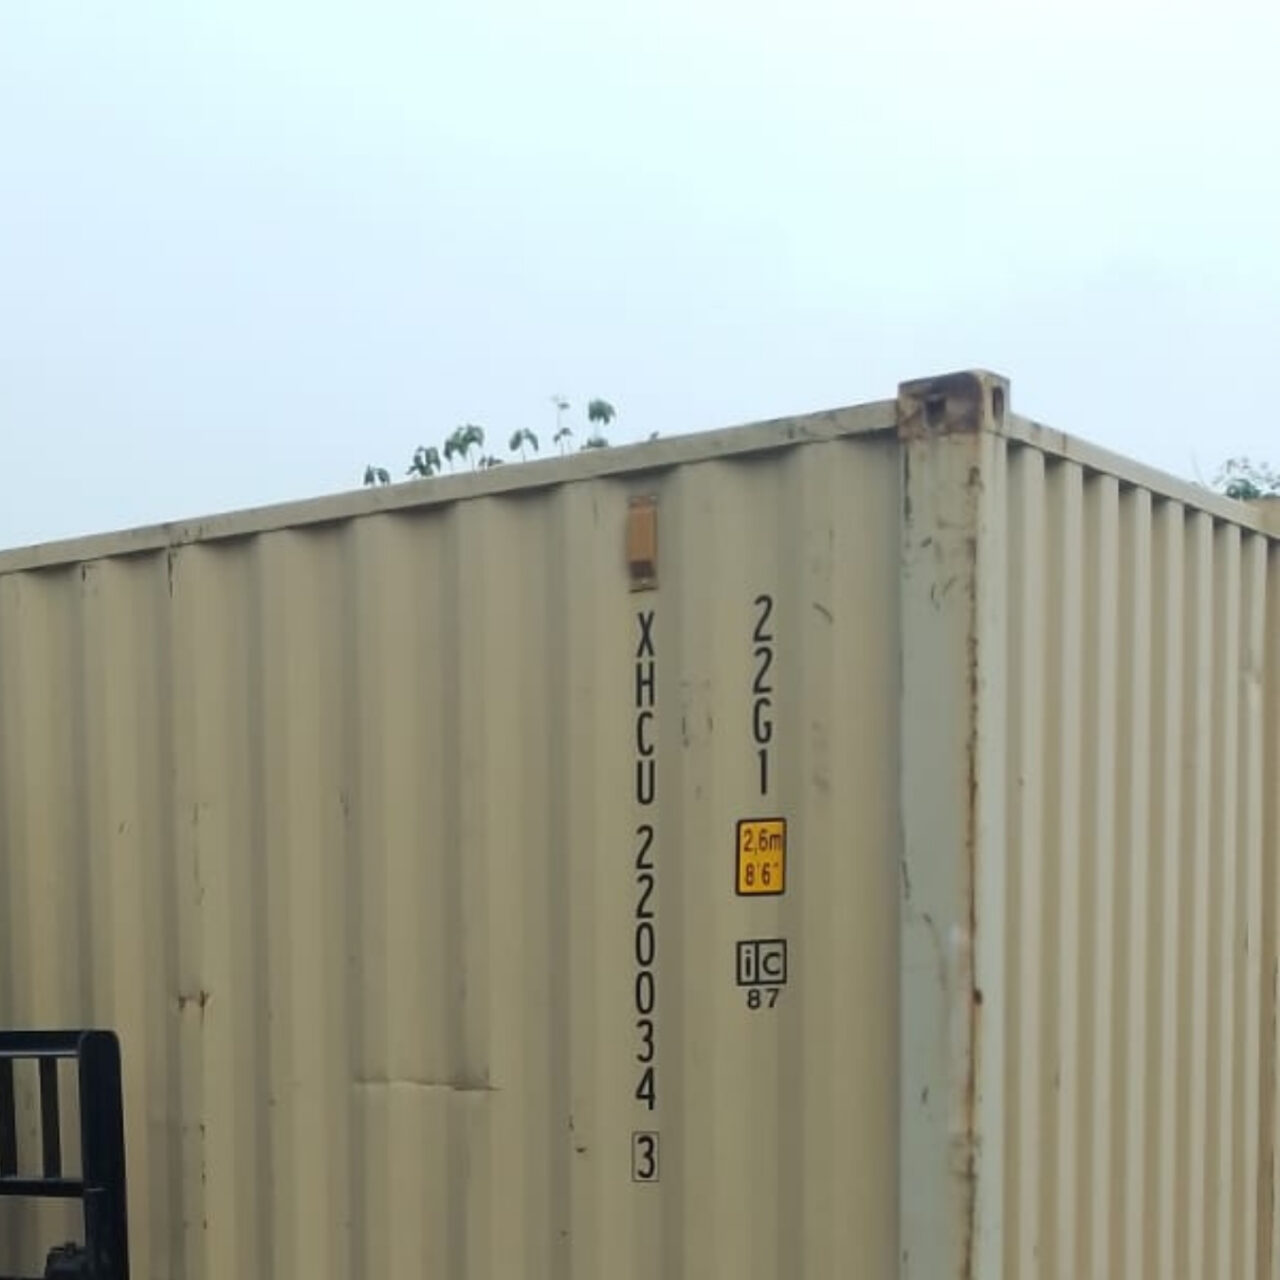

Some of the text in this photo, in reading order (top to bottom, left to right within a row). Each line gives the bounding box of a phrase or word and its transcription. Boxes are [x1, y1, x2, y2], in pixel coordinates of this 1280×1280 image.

[752, 594, 773, 795] 22G1
[634, 610, 656, 1179] XHCU 220034 3
[747, 988, 780, 1010] 87
